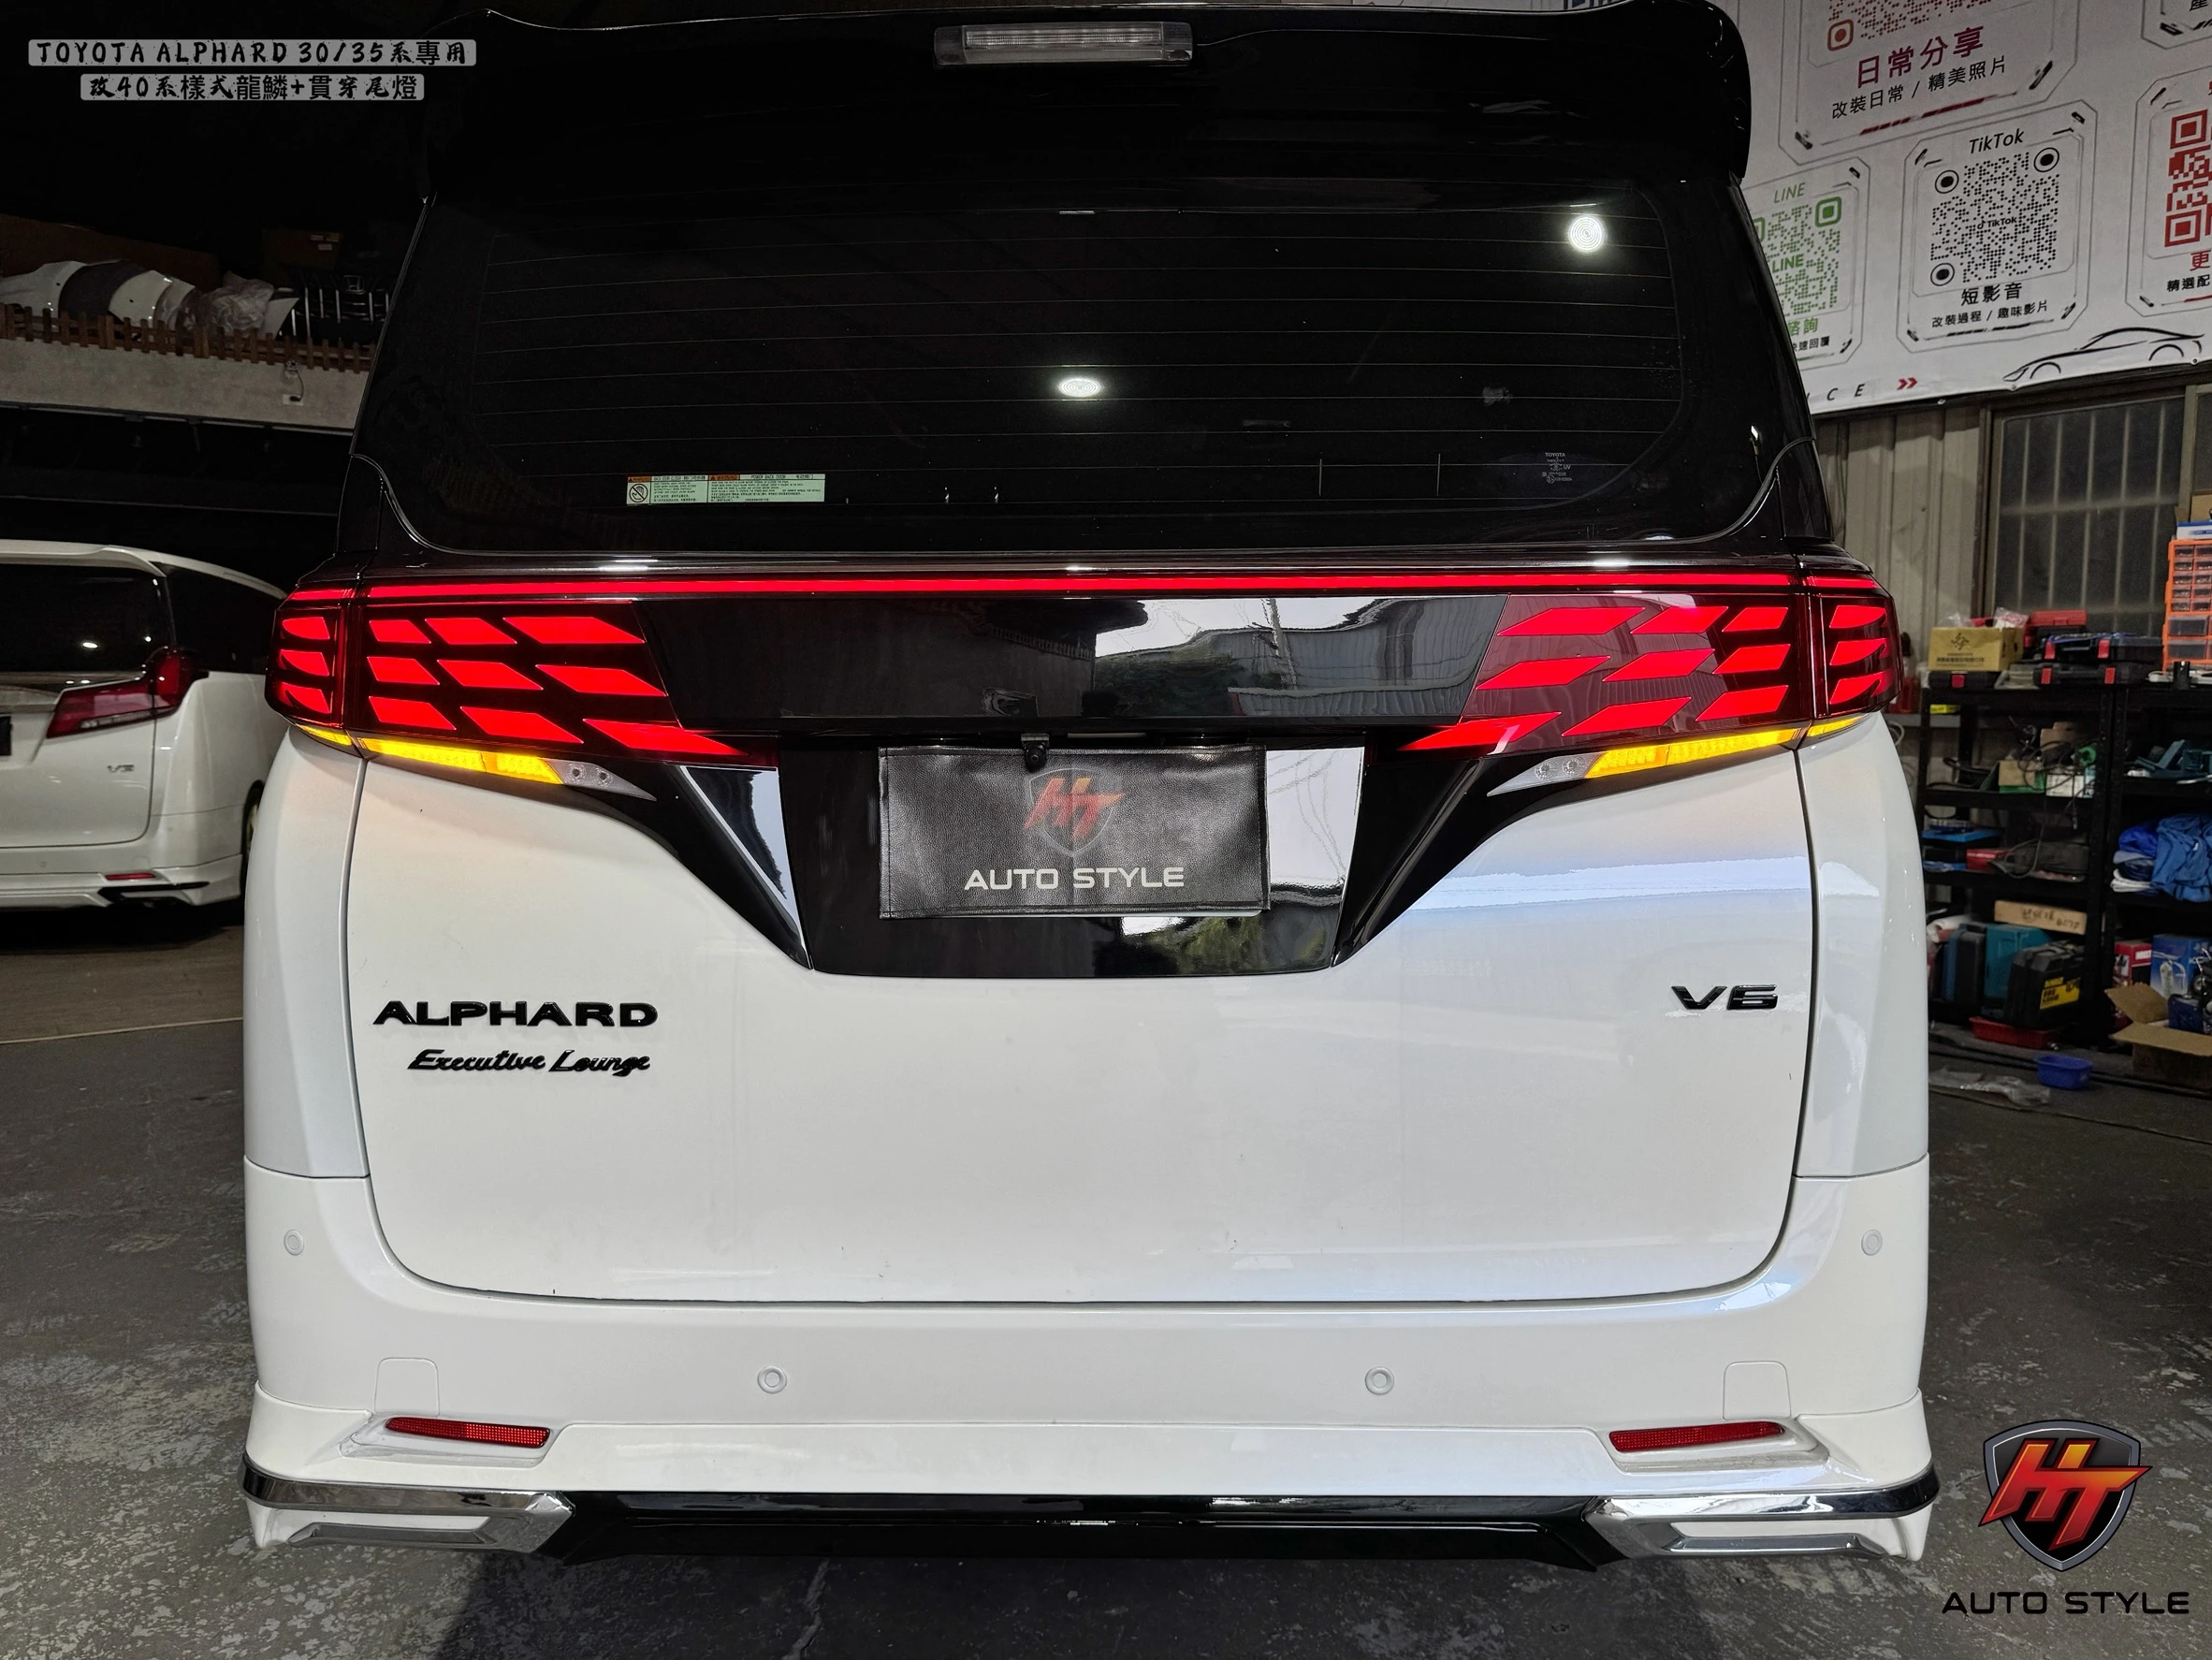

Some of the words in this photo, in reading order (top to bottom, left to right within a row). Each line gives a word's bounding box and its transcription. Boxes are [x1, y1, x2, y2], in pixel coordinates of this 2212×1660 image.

[1857, 25, 1984, 89] 日常分享
[1832, 83, 1904, 119] 改裝日常
[1928, 55, 2006, 92] 精美照片
[1970, 128, 2025, 153] TikTok
[1774, 182, 1806, 203] LINE
[1987, 216, 2017, 228] TikTok
[1771, 254, 1804, 273] LINE
[2190, 249, 2211, 271] 更
[1960, 282, 2022, 306] 短影音
[1931, 310, 1982, 328] 改裝過程
[1998, 300, 2047, 319] 趣味影片
[964, 867, 1058, 890] AUTO
[1073, 866, 1185, 889] STYLE
[1671, 984, 1778, 1011] V6
[372, 1000, 659, 1027] ALPHARD
[407, 1048, 546, 1070] Executive
[548, 1049, 651, 1077] Lounge
